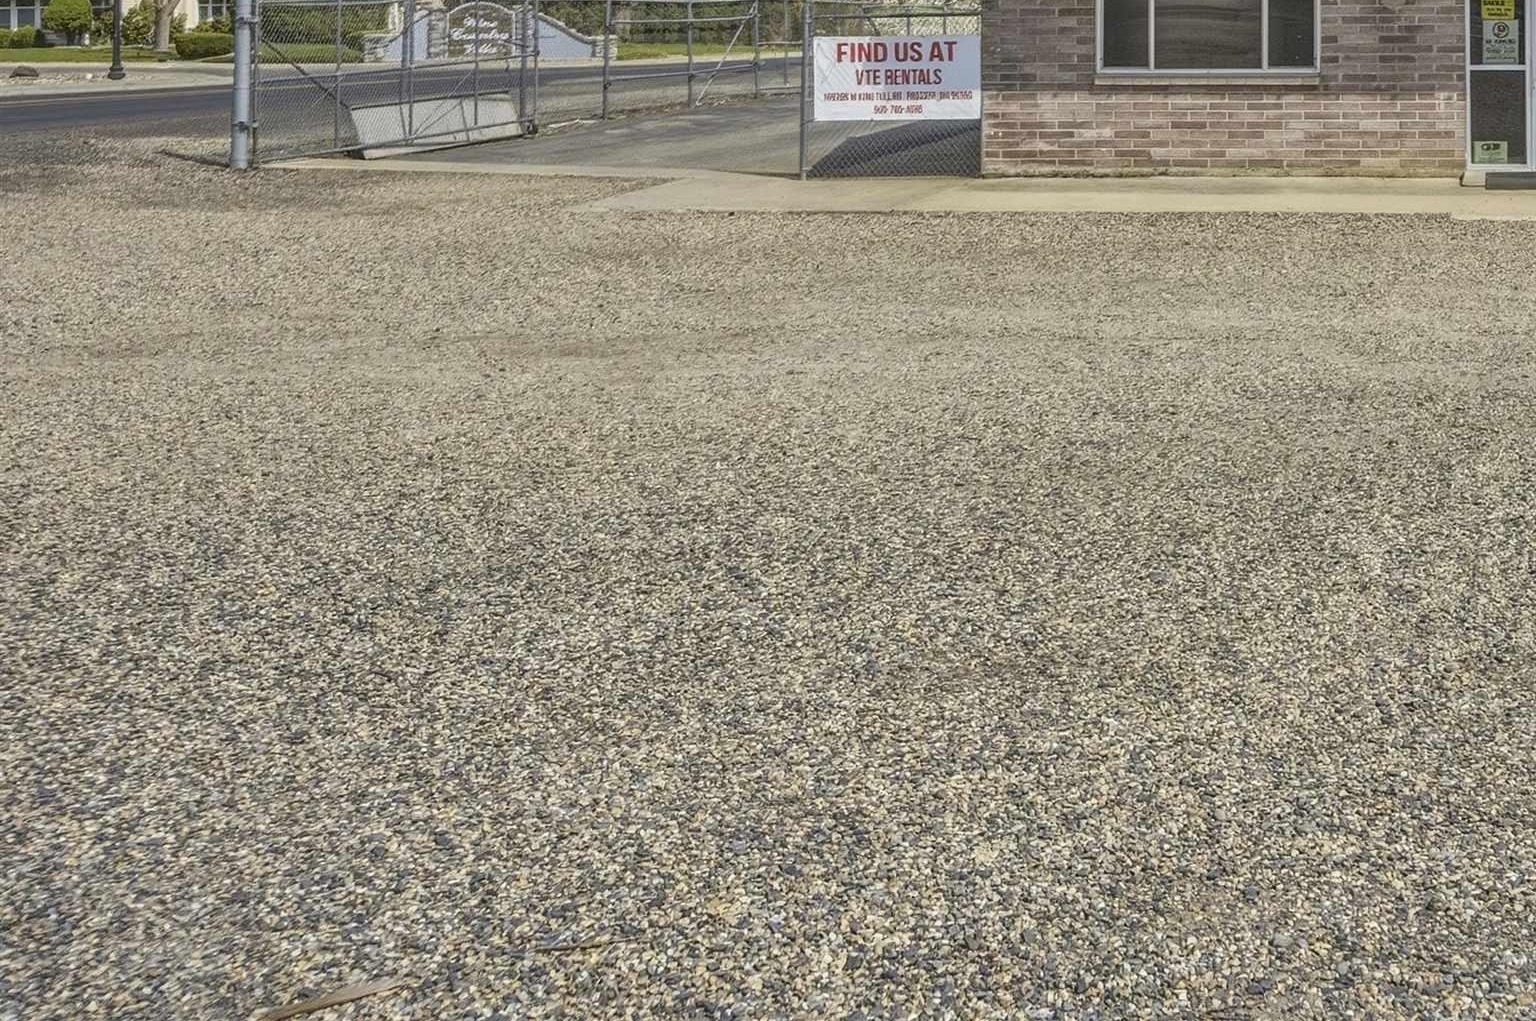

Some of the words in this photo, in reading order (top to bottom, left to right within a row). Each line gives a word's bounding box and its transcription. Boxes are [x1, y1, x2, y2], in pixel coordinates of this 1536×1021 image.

[836, 42, 888, 63] FIND
[894, 41, 923, 63] US
[929, 41, 958, 62] AT
[855, 68, 881, 86] VTE
[884, 68, 943, 85] RENTALS
